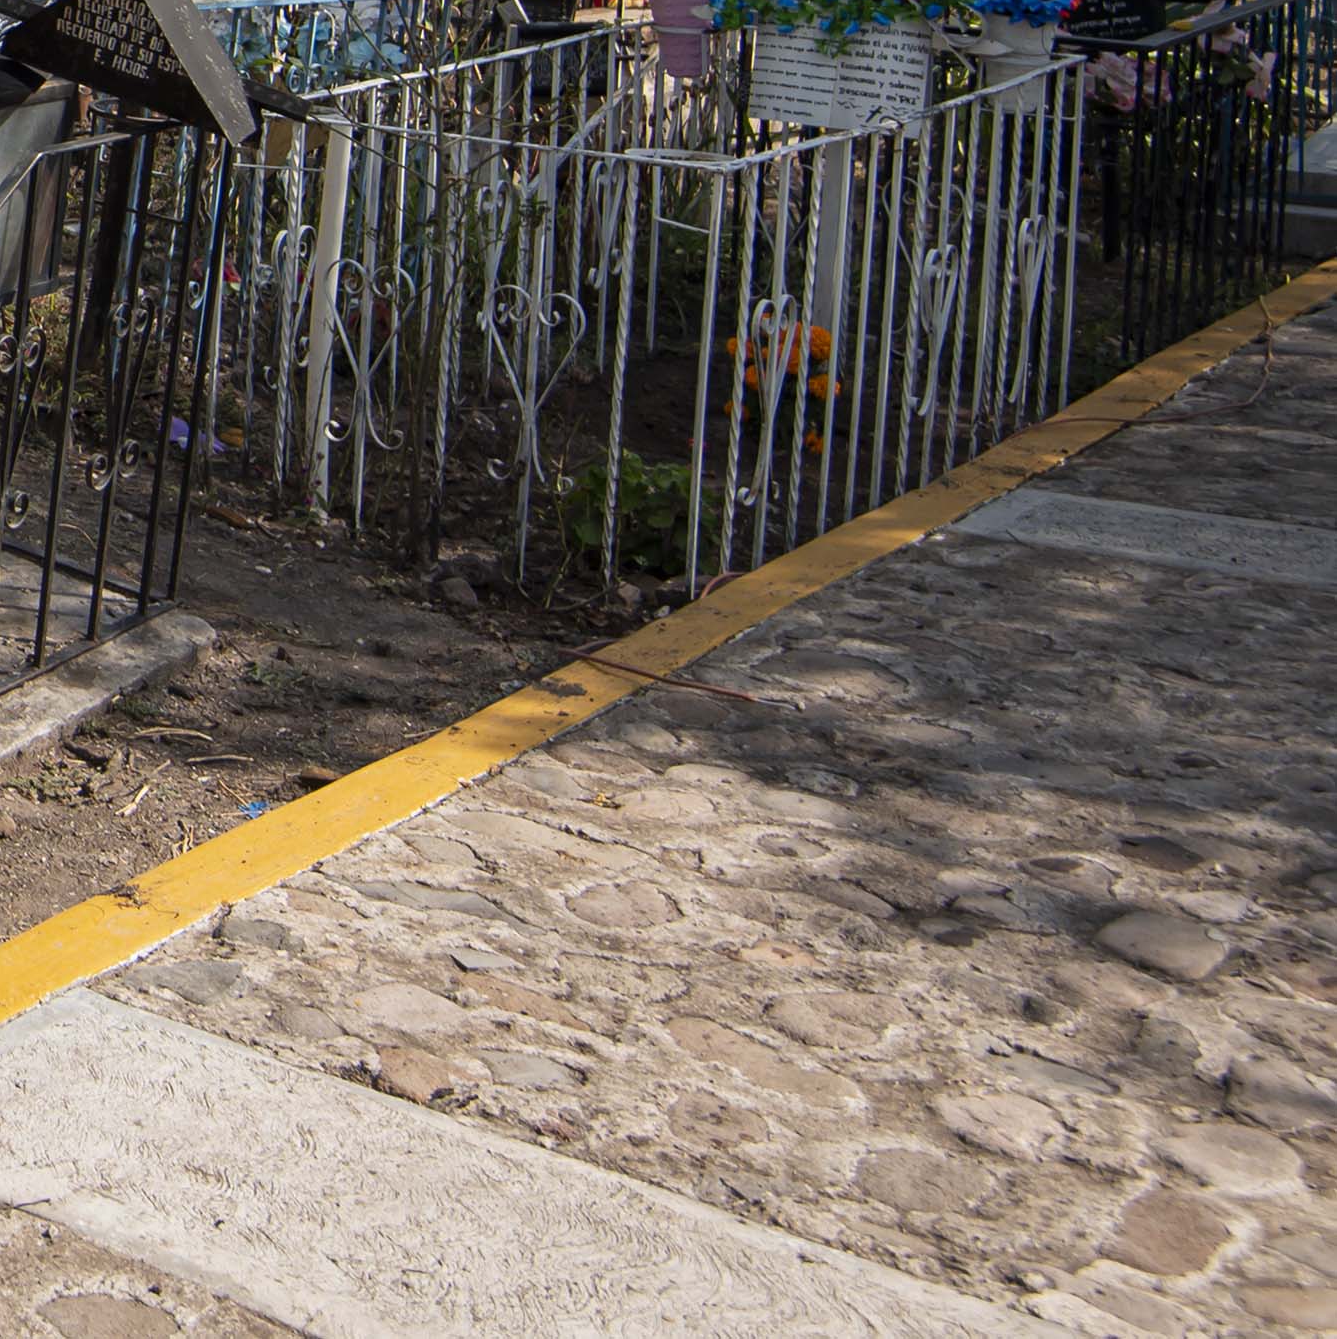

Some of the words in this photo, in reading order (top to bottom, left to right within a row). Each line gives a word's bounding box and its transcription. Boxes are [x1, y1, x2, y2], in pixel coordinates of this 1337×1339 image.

[56, 18, 117, 52] RECUERDO
[120, 42, 134, 59] DE
[137, 47, 155, 65] SU
[76, 10, 91, 25] LA
[95, 16, 126, 39] EDAD
[131, 28, 146, 45] DE
